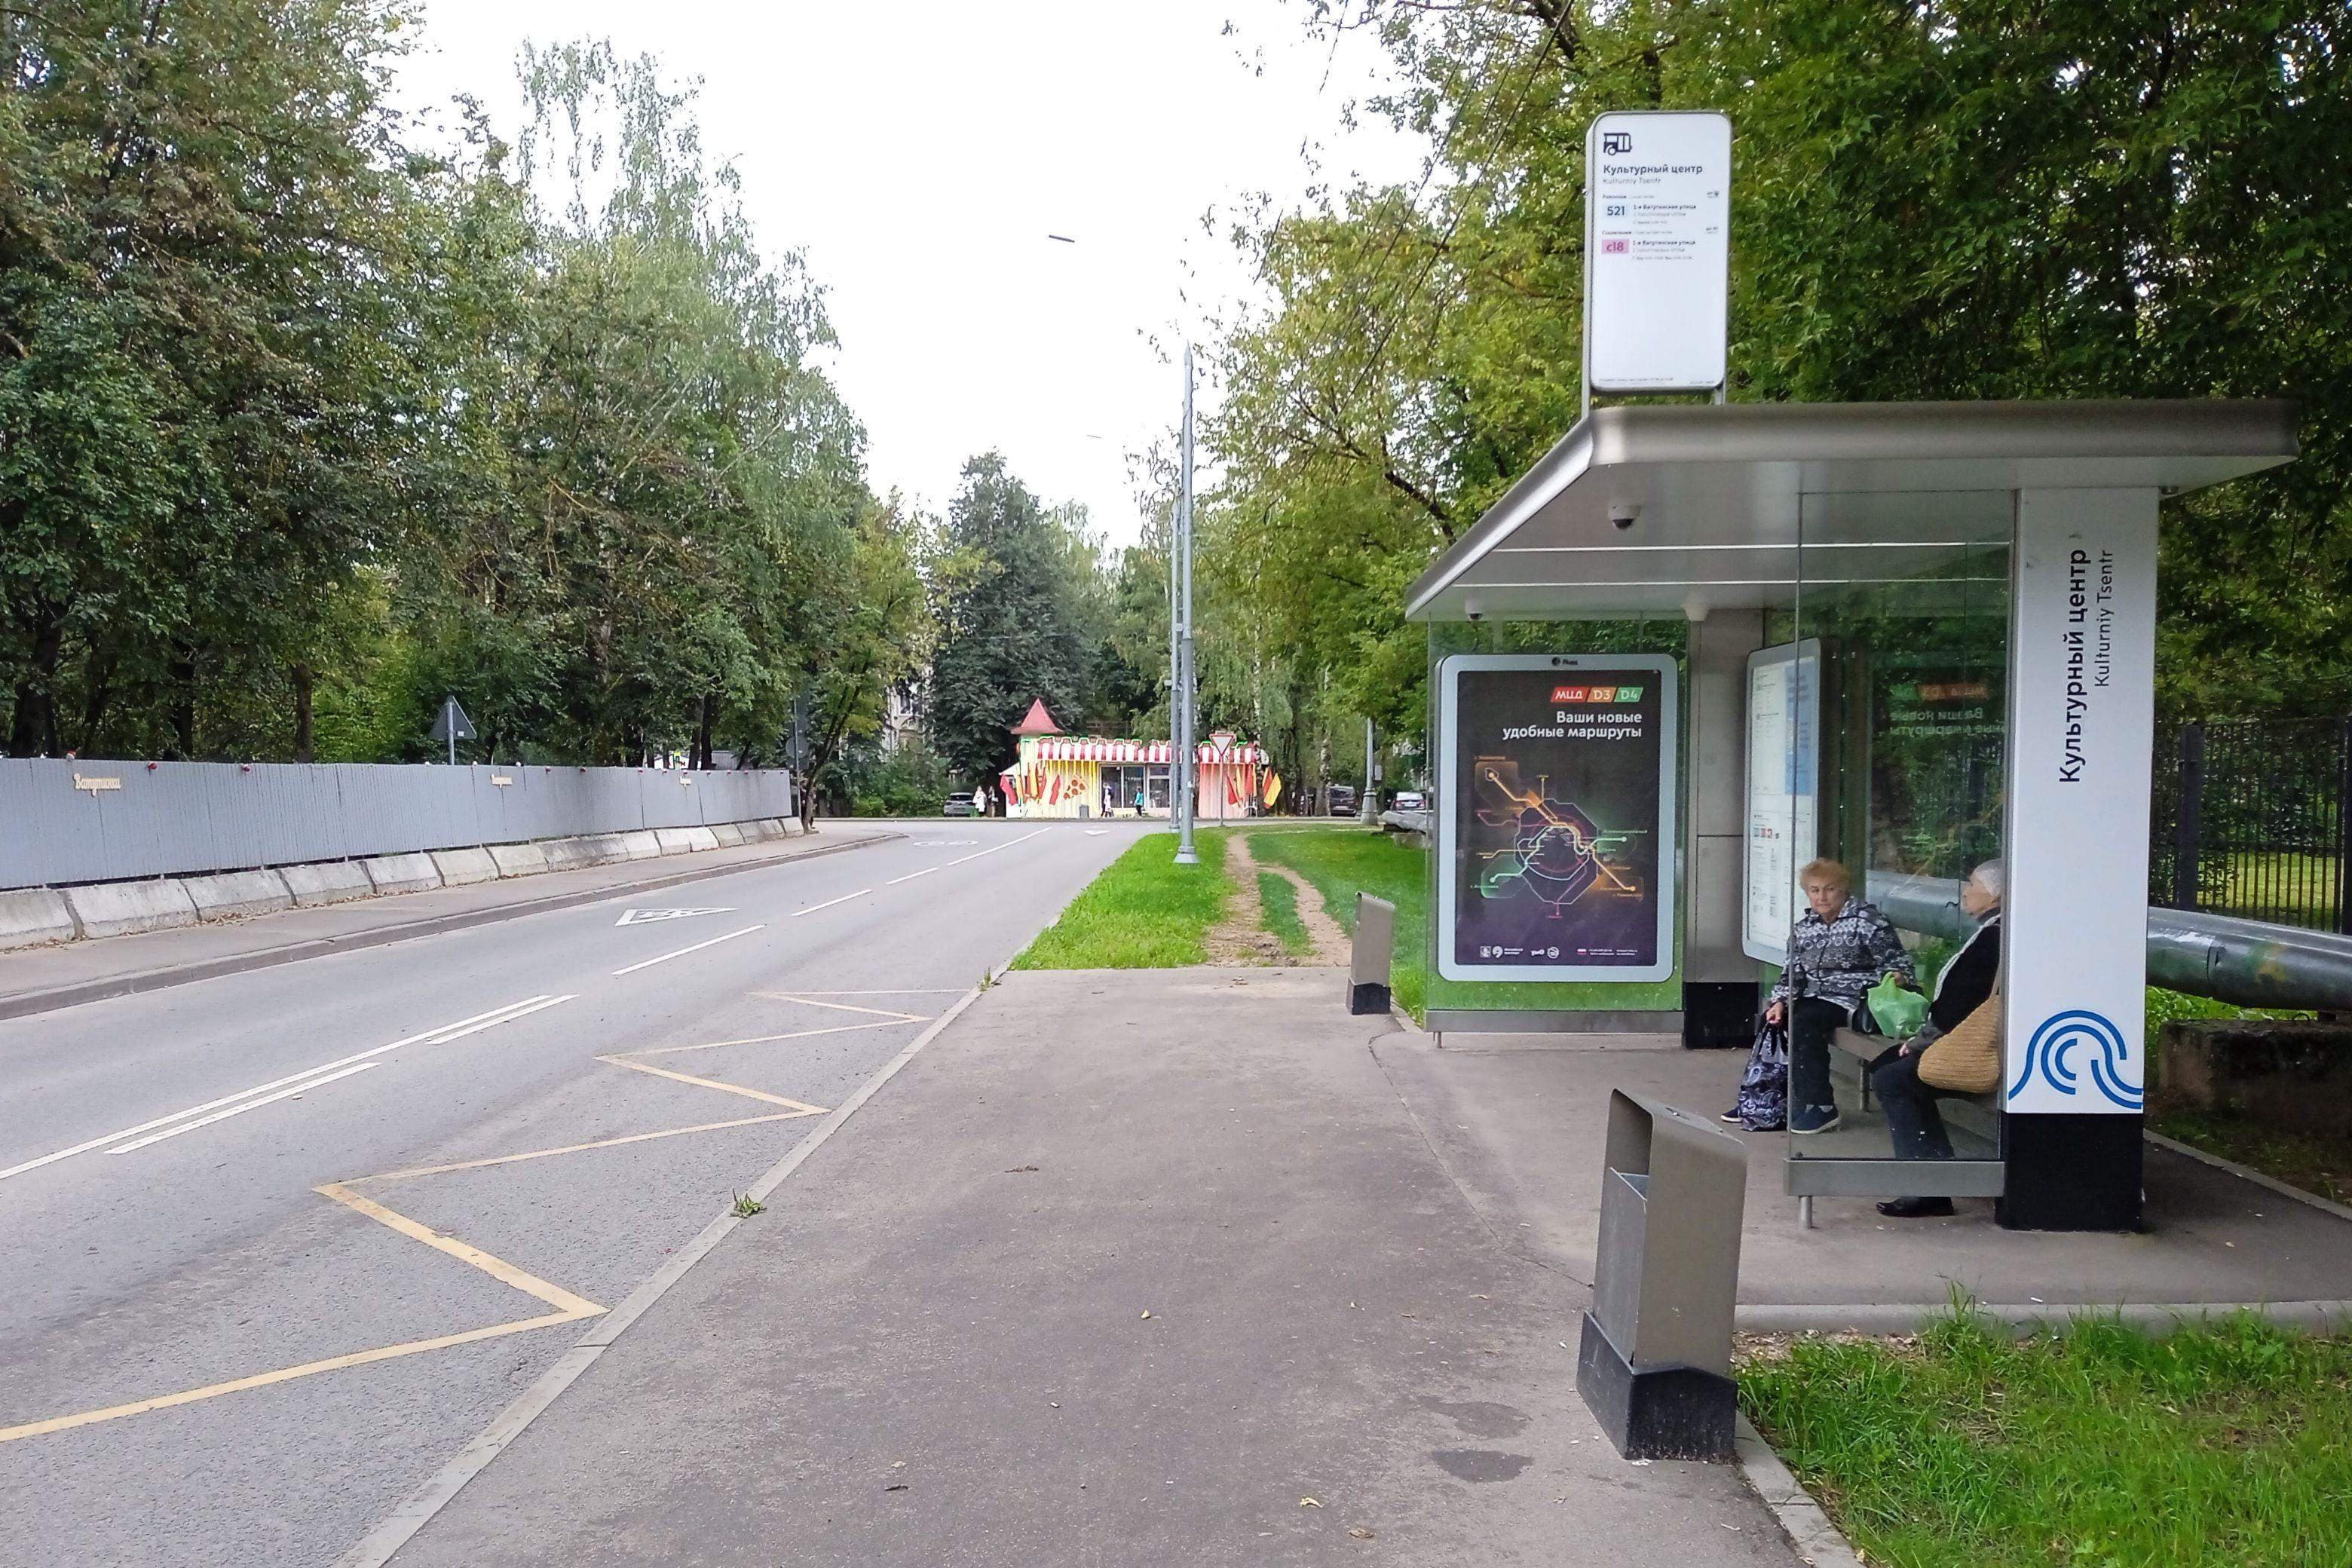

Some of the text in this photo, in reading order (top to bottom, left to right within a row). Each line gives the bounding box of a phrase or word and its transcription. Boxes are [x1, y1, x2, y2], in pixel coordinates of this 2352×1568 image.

[1603, 164, 1703, 175] Культурный центр
[1607, 206, 1625, 216] 521
[2094, 550, 2115, 688] Kulturniy Tsentr
[2058, 549, 2091, 782] Культурный центр
[1555, 690, 1583, 700] МЦД
[1593, 689, 1611, 700] D3
[1620, 689, 1638, 700] D4
[1556, 711, 1643, 723] Ваши новые
[1502, 724, 1643, 740] удобные маршруты
